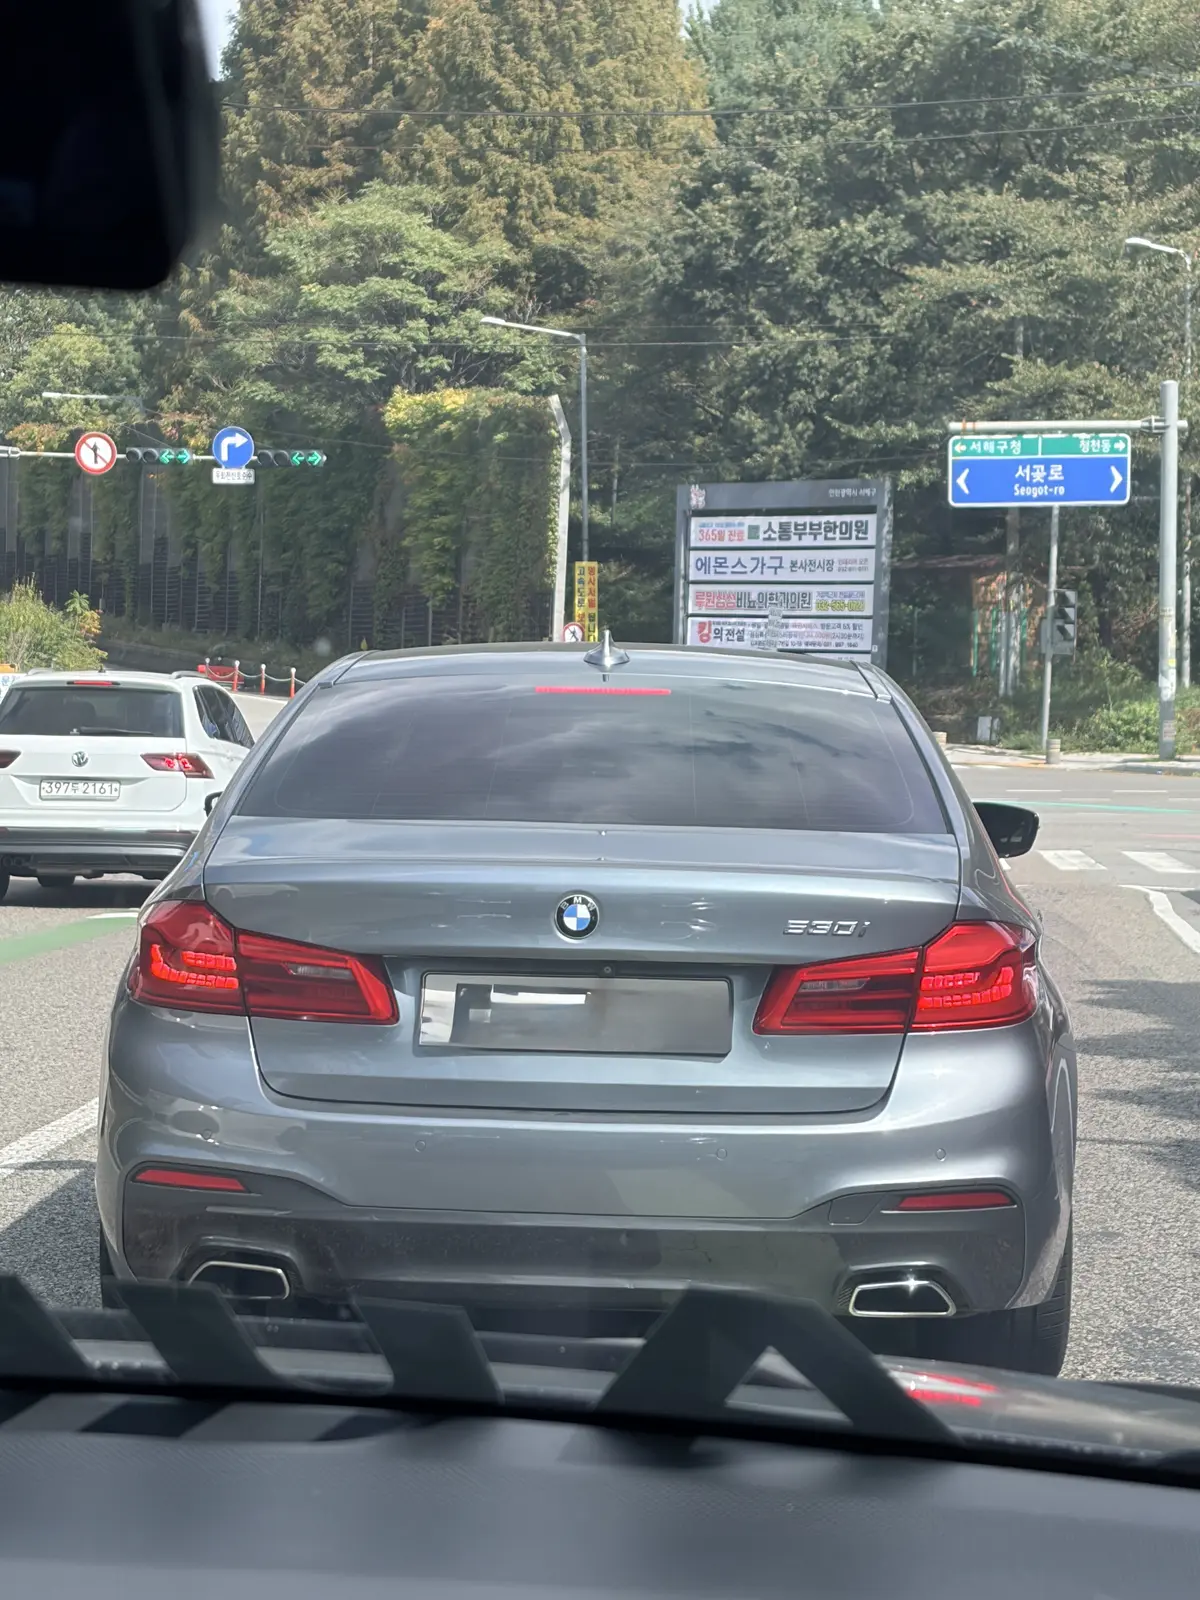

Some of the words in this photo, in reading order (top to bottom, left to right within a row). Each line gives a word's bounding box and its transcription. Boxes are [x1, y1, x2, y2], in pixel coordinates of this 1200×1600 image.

[970, 440, 1021, 454] 서해구청
[1015, 464, 1064, 482] 서곶로
[1014, 484, 1065, 498] Seogot-ro
[698, 529, 726, 542] 365일
[727, 529, 745, 542] 진료
[762, 519, 869, 542] 소통부부한의원
[695, 555, 785, 576] 에몬스가구
[789, 558, 835, 573] 본사전시장
[82, 782, 113, 795] 2161
[560, 896, 596, 911] BMW
[783, 919, 871, 938] 530i
